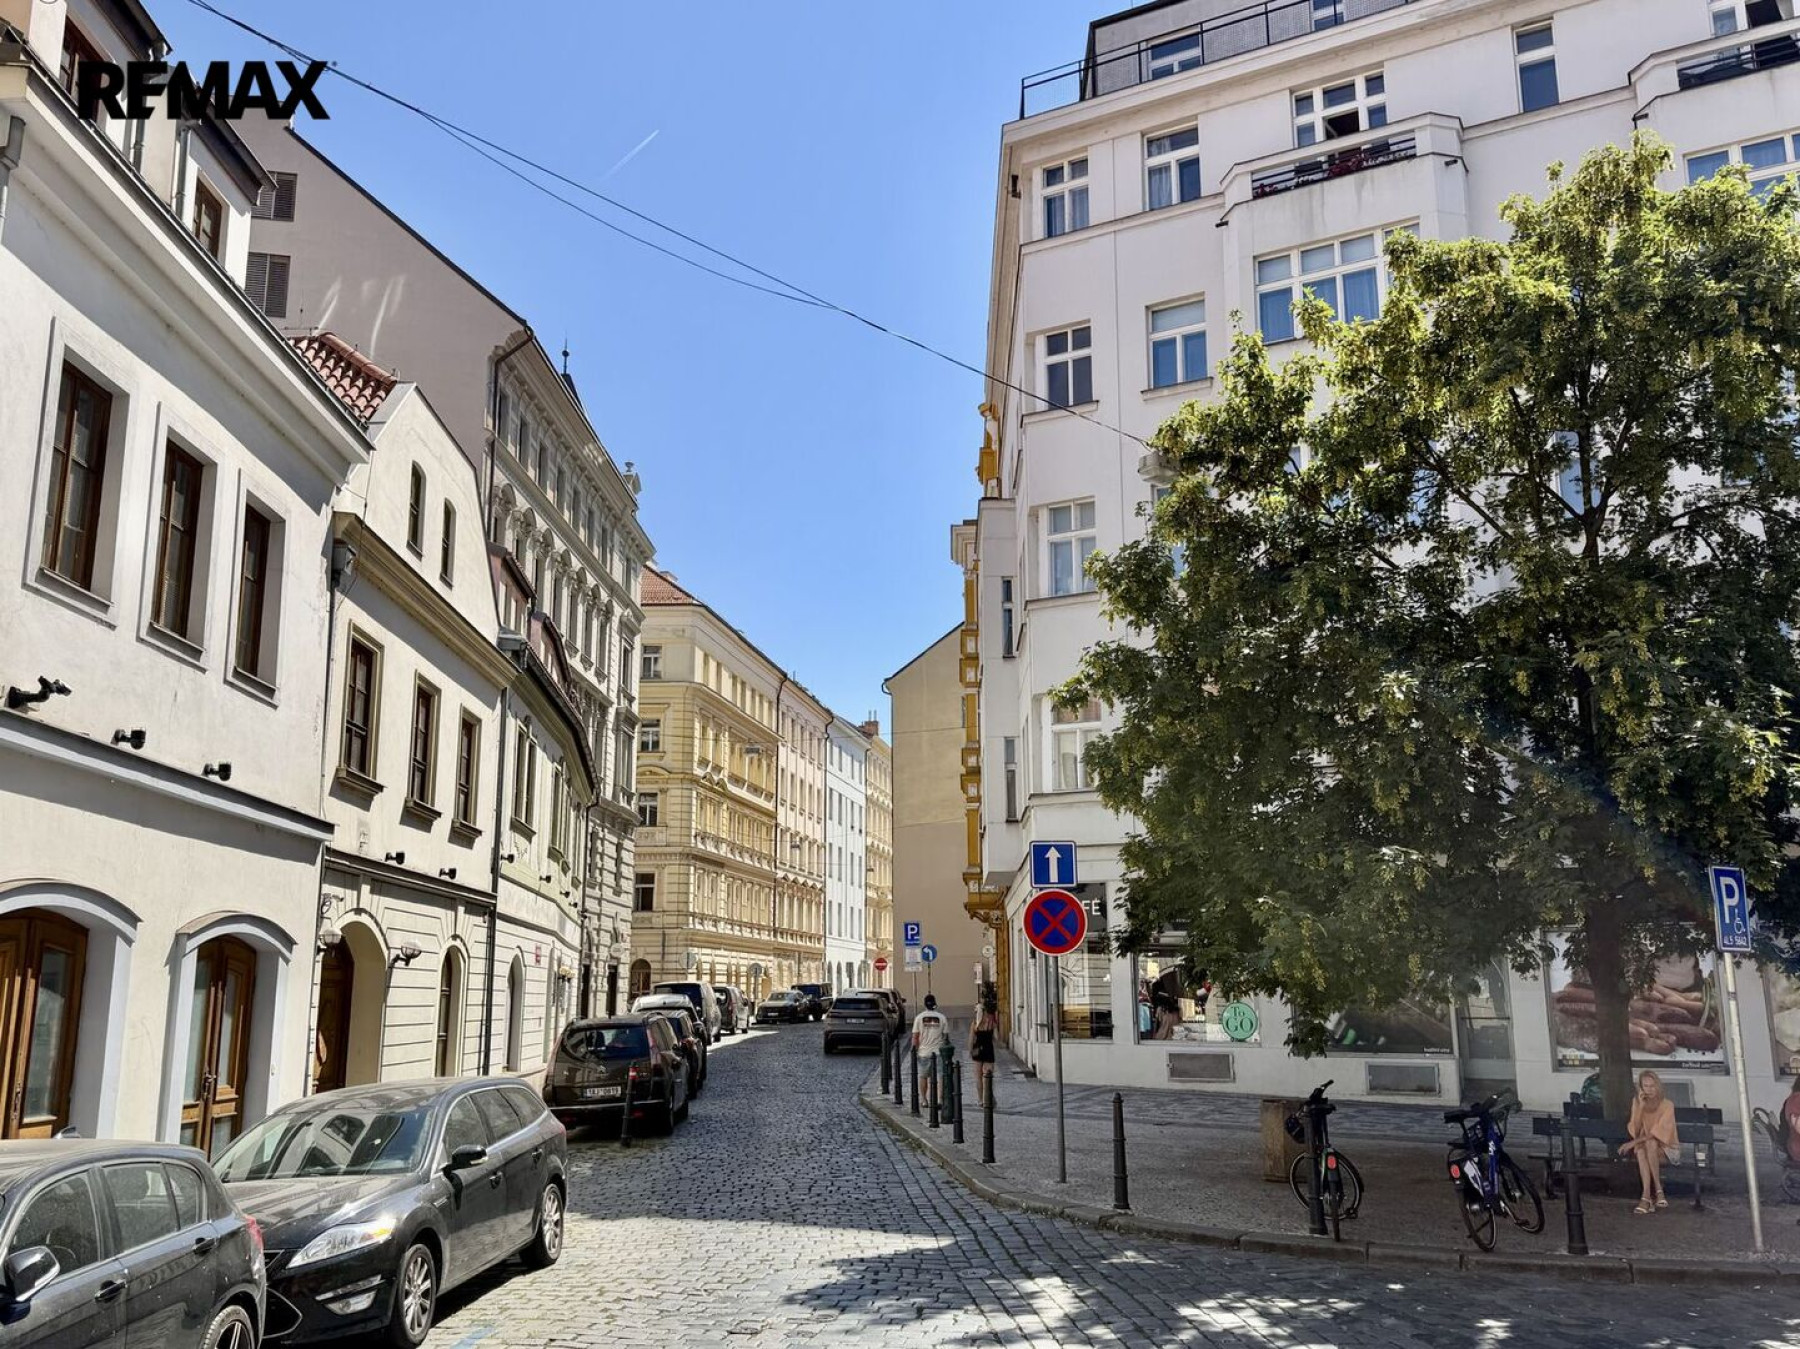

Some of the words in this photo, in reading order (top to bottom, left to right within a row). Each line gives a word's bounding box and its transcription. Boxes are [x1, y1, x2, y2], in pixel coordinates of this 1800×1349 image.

[1082, 897, 1101, 915] FÉ
[1719, 876, 1739, 923] P
[907, 925, 918, 939] P
[1226, 1017, 1253, 1032] GO
